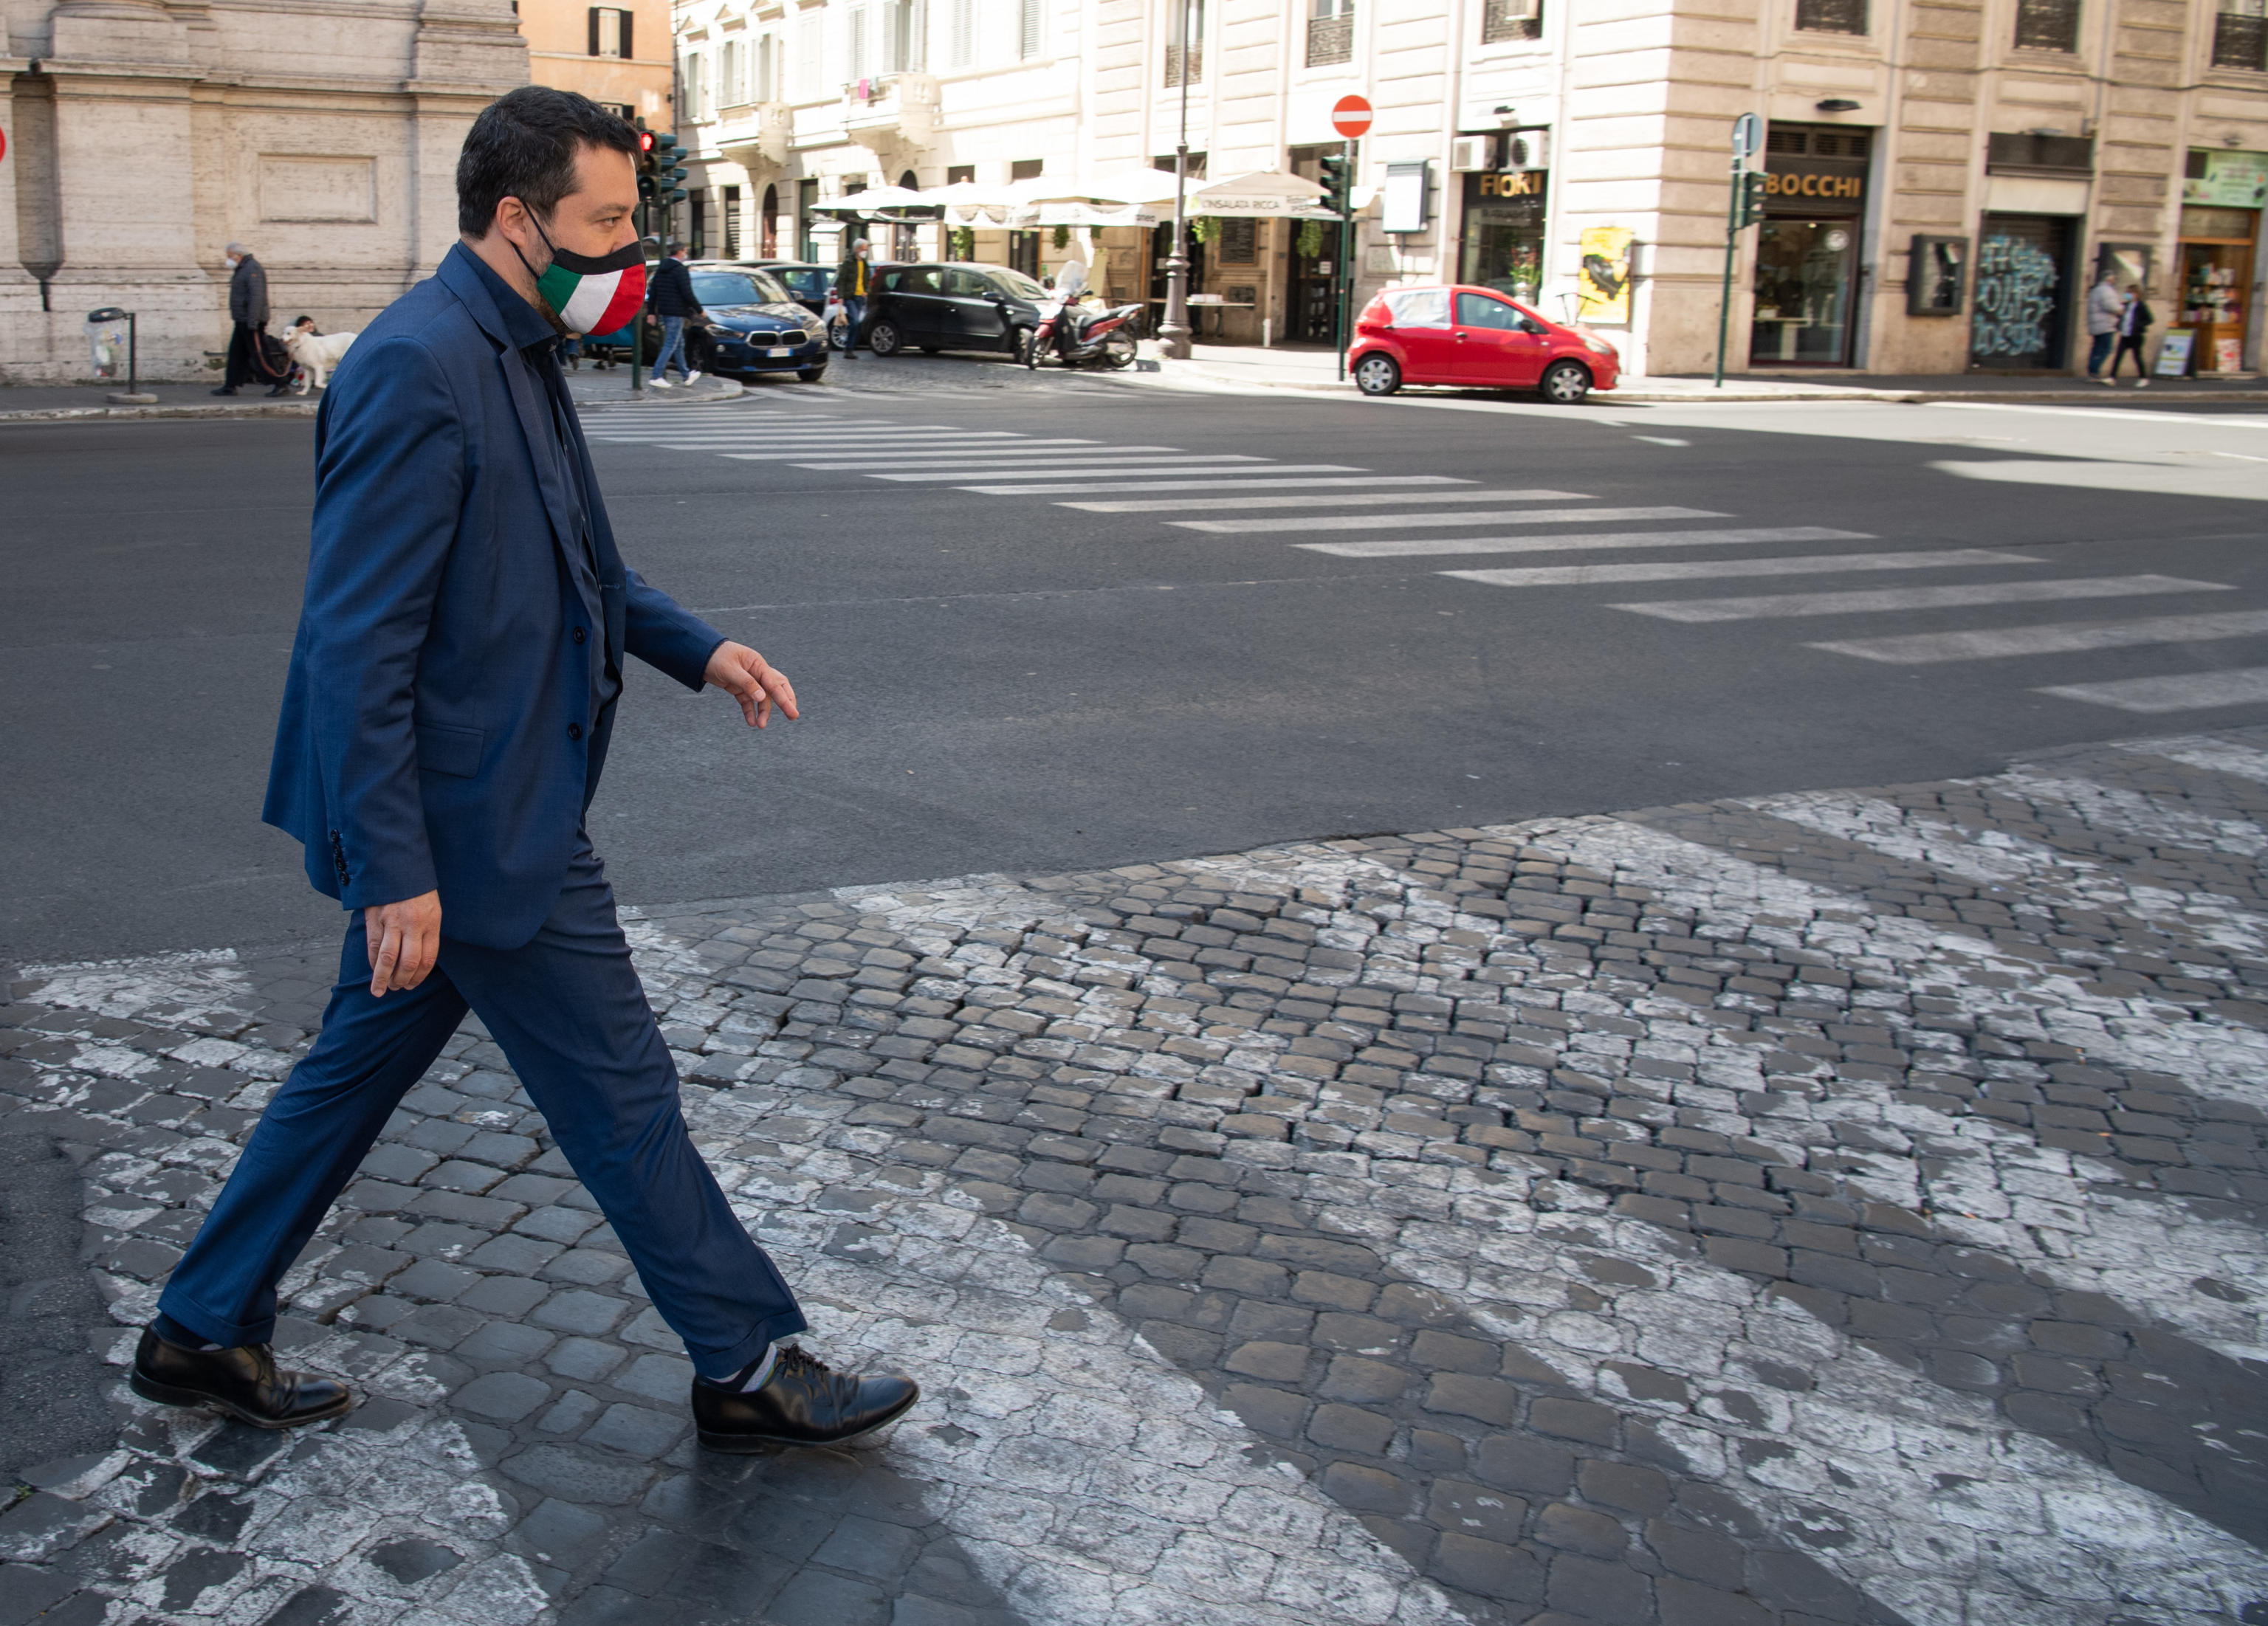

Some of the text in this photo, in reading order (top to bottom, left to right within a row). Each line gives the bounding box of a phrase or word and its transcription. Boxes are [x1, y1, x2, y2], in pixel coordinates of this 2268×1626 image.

[1480, 173, 1542, 197] FIORI
[1765, 173, 1860, 198] BOCCHI
[1253, 200, 1281, 210] RICCA
